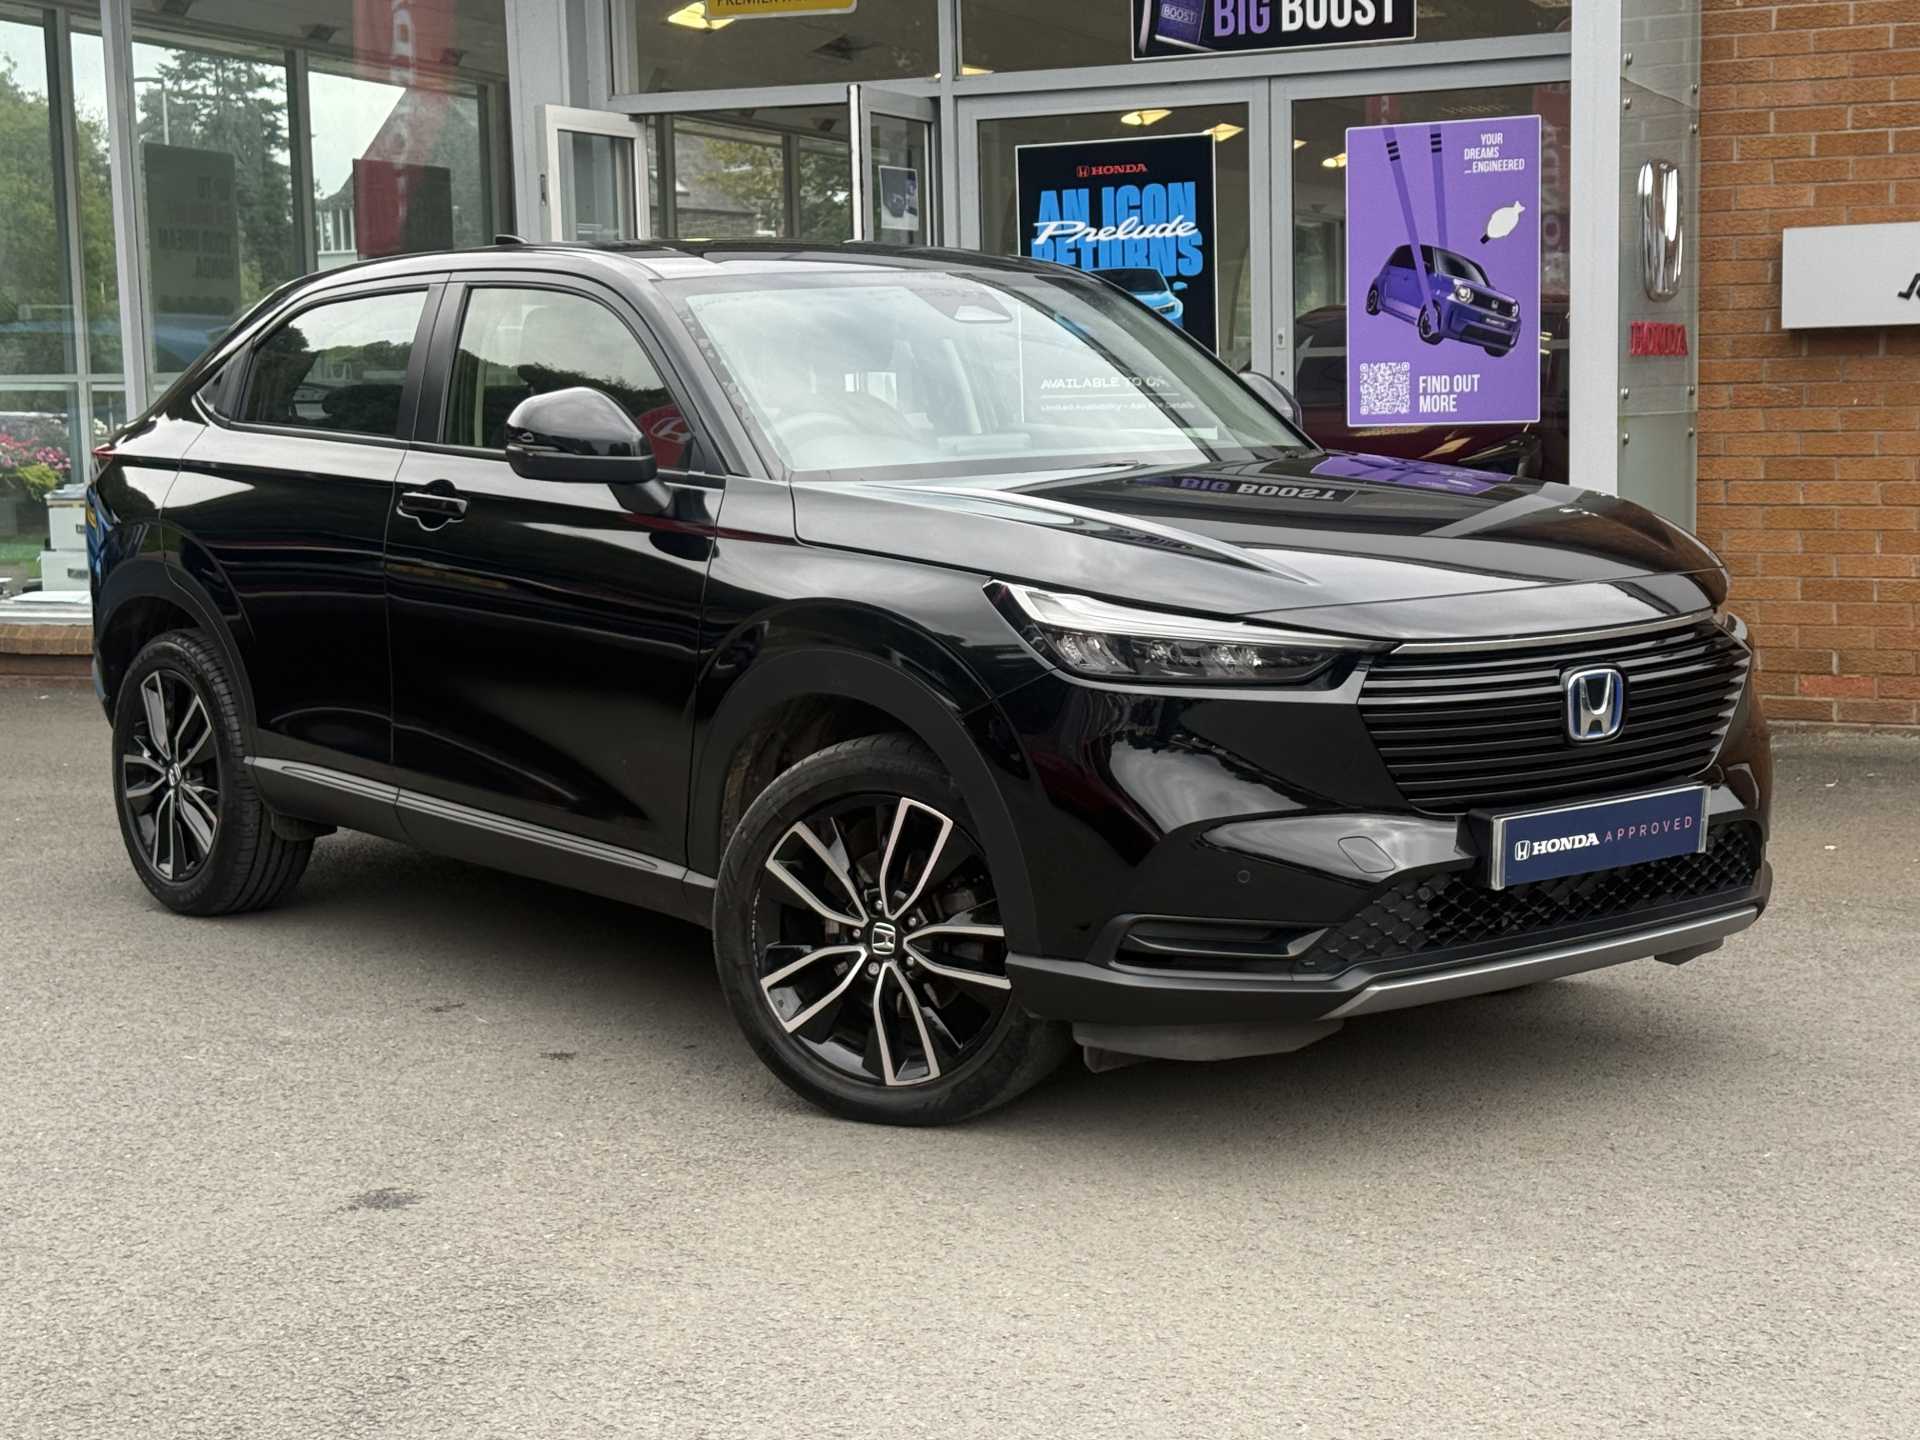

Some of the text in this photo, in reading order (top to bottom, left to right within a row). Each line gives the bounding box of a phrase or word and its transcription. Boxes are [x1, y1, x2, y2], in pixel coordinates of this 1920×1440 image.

[1164, 5, 1194, 22] BOOST
[1214, 0, 1270, 37] BIG
[1480, 131, 1504, 146] YOUR
[1463, 146, 1500, 161] DREAMS
[1091, 163, 1148, 177] HONDA
[1037, 181, 1196, 236] AN ICON
[1033, 214, 1199, 245] Prelude
[1630, 321, 1688, 356] HONDA
[1040, 376, 1121, 390] AVAILABLE
[1419, 374, 1481, 394] FIND OUT
[1419, 395, 1458, 413] MORE
[1532, 815, 1694, 856] HONDA APPROVED
